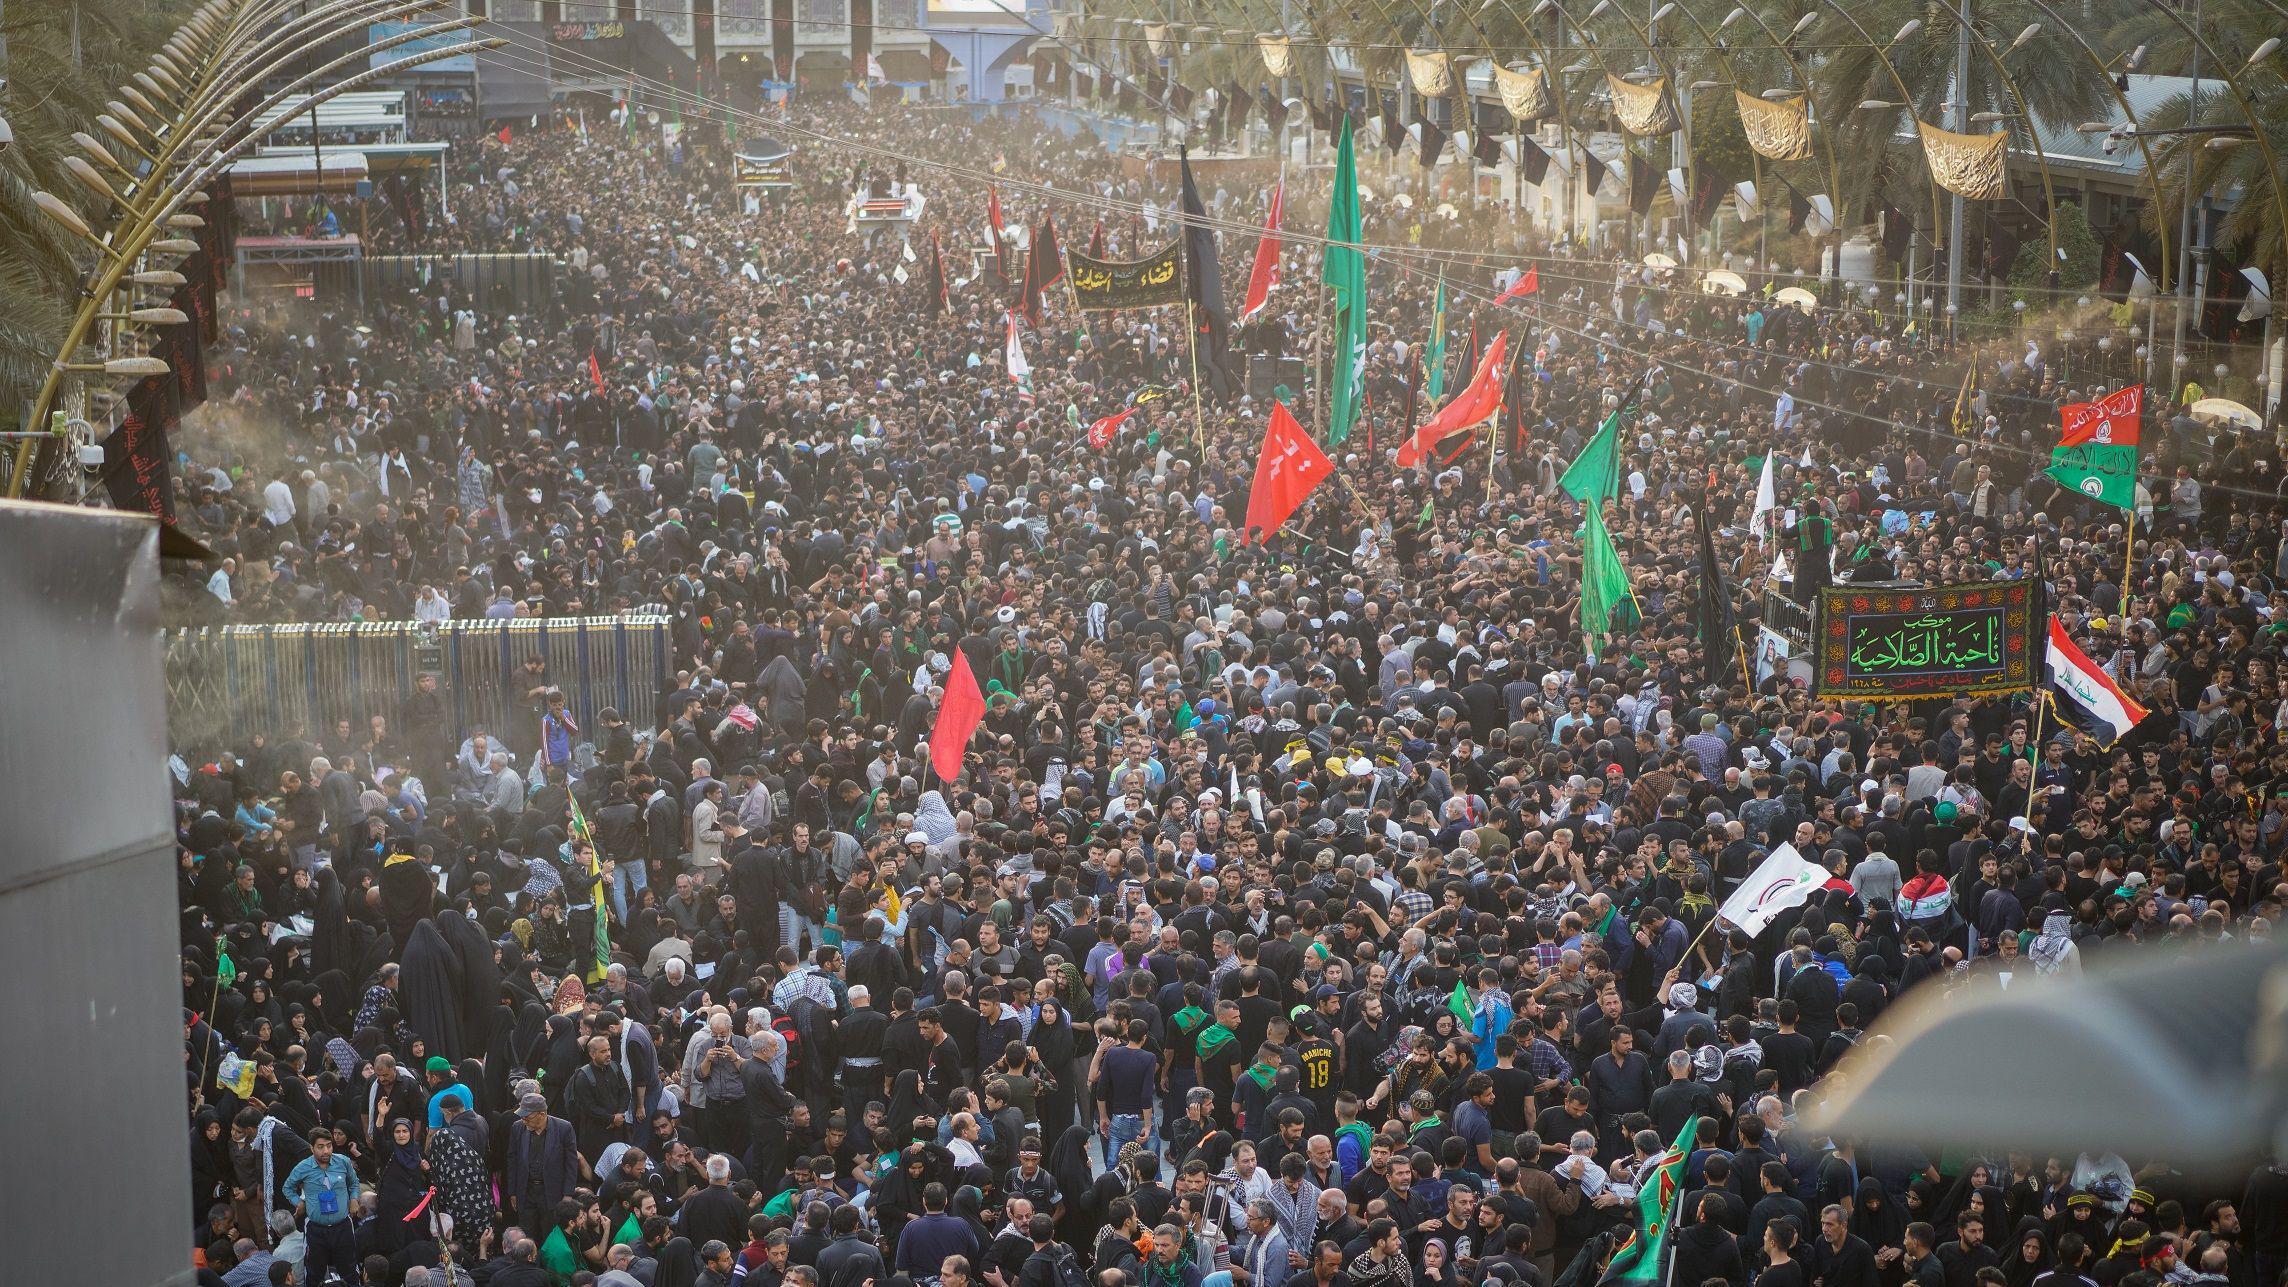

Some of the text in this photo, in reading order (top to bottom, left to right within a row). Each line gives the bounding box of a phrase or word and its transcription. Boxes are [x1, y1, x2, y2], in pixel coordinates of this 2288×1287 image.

[1141, 261, 1174, 286] قضاء
[1904, 614, 1952, 629] موكب
[1308, 1060, 1329, 1088] 18
